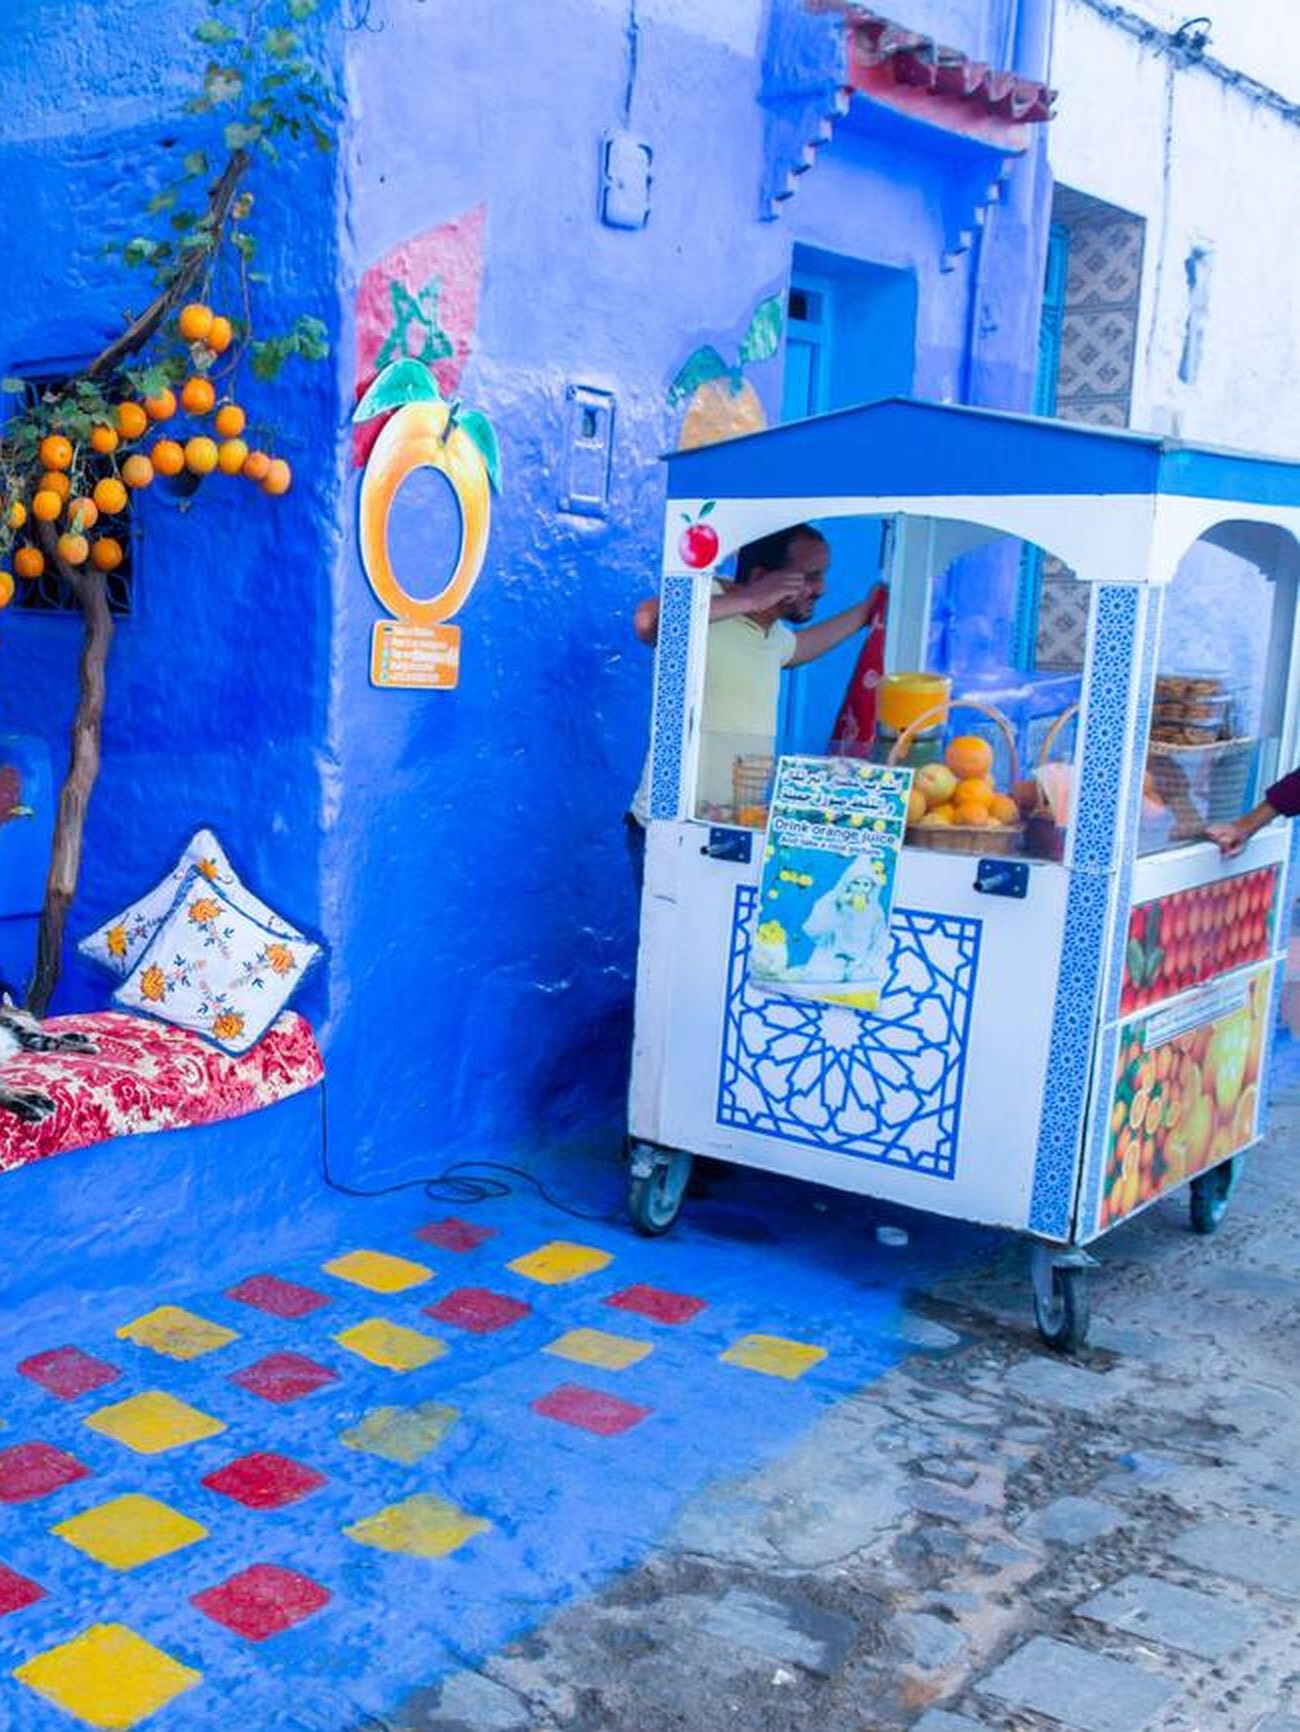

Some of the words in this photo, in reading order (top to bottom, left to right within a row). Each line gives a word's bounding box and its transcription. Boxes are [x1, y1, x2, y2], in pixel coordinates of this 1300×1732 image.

[775, 820, 809, 833] Drink
[811, 825, 859, 842] orange
[860, 831, 895, 846] juice
